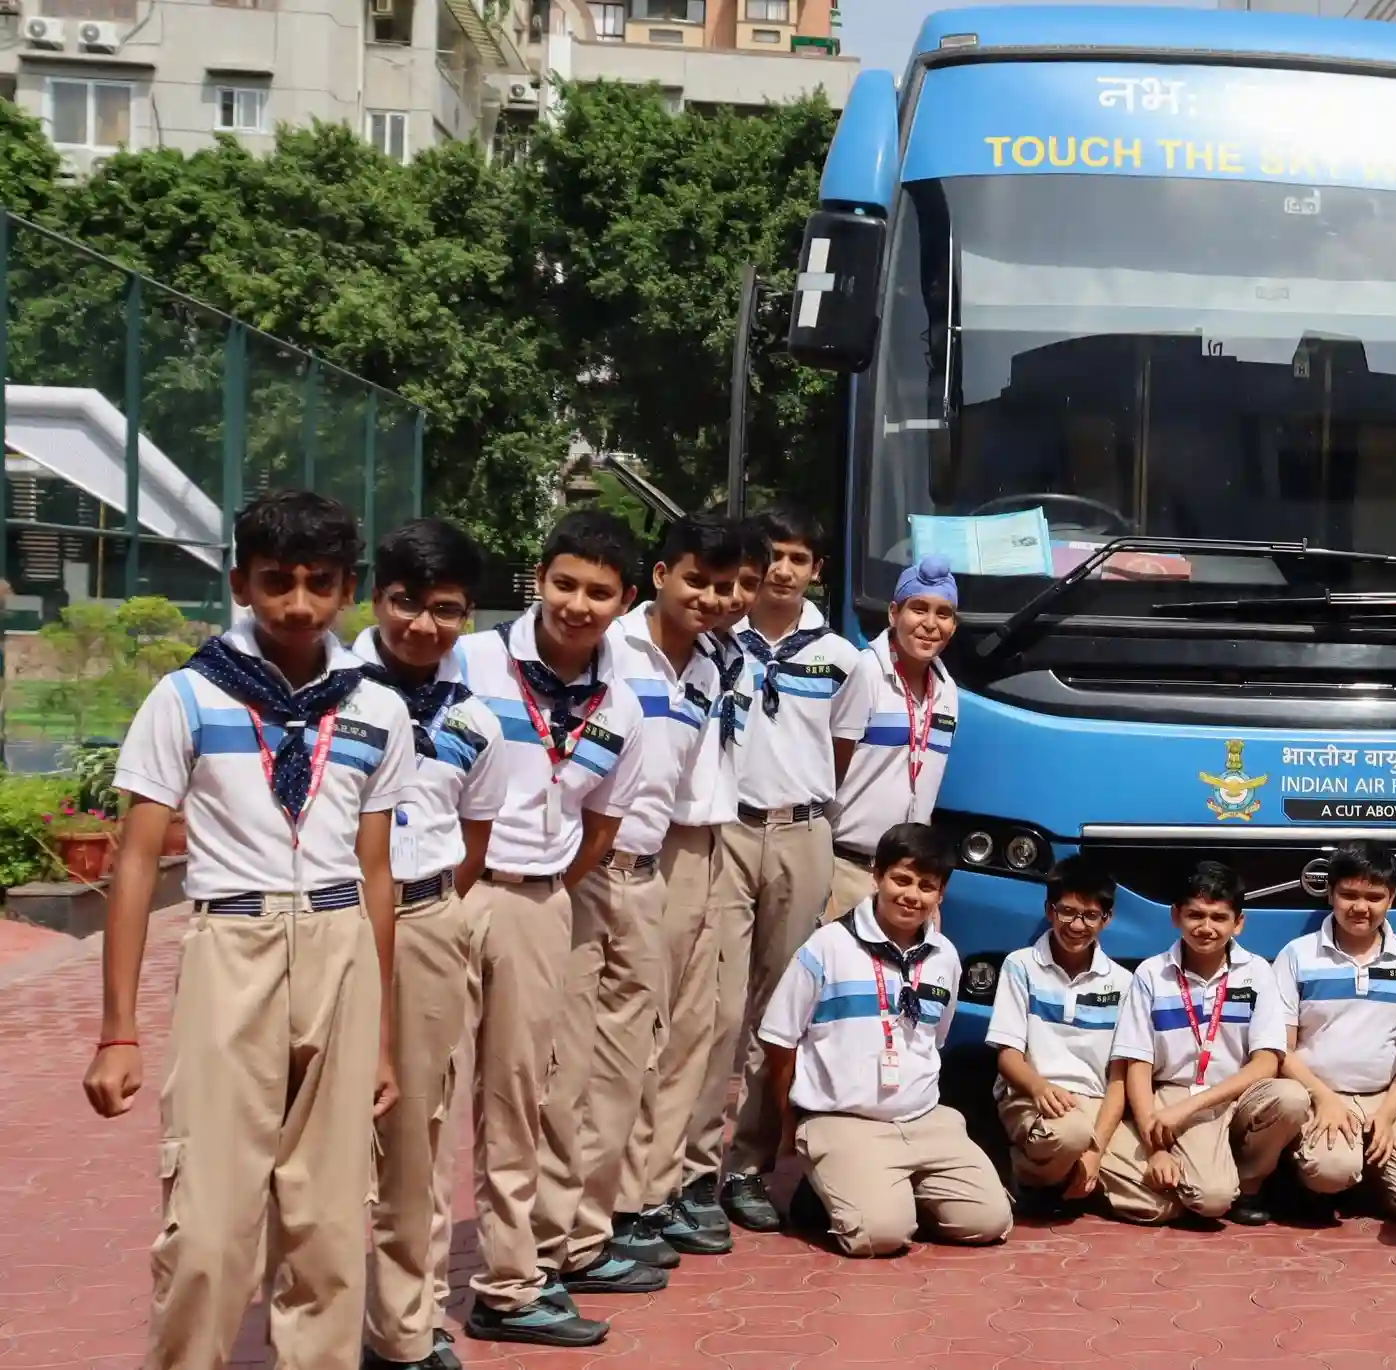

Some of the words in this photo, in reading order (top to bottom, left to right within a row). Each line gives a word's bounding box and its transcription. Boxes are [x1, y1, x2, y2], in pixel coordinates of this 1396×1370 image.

[985, 135, 1142, 168] TOUCH
[1158, 138, 1245, 173] THE
[1282, 744, 1358, 767] भारतीय
[1281, 776, 1348, 793] INDIAN
[1354, 777, 1385, 793] AIR
[1321, 805, 1332, 817] A
[1335, 805, 1362, 817] CUT
